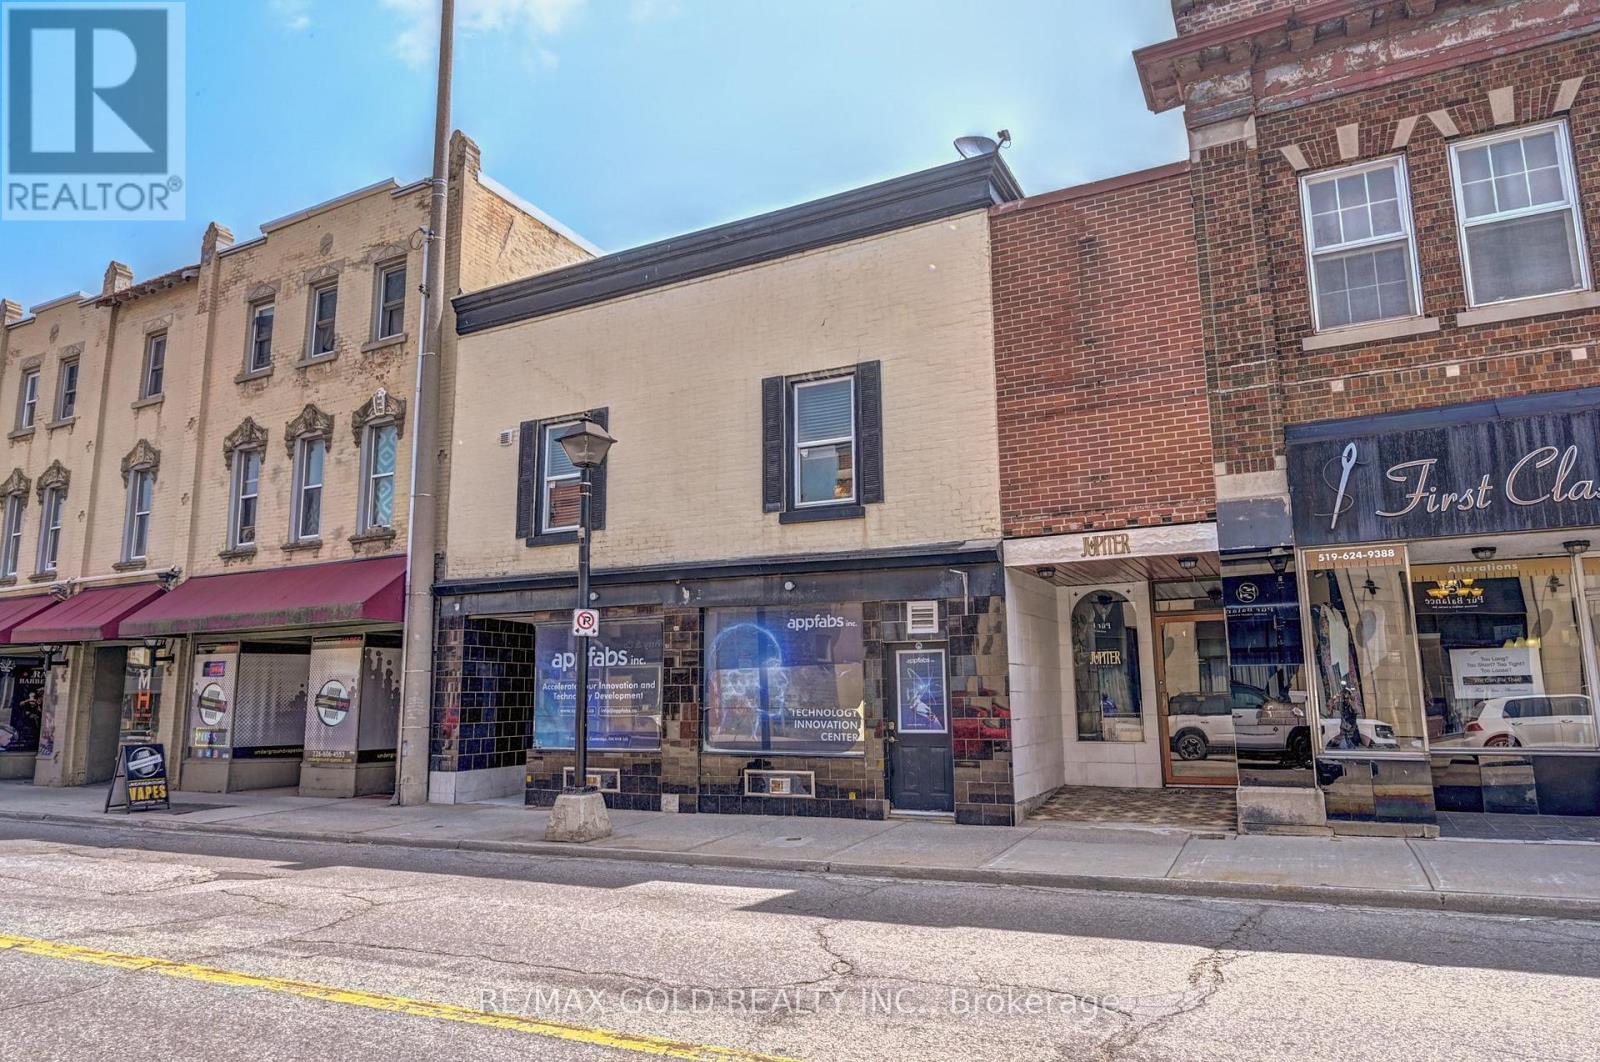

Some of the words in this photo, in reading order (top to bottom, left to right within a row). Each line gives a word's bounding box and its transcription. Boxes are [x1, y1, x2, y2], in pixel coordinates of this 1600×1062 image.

[1376, 458, 1494, 517] First
[1081, 533, 1131, 557] JUPITER
[1318, 549, 1395, 562] 519-624-9388
[1448, 563, 1518, 573] Alterations
[787, 614, 844, 631] appfabs
[630, 656, 647, 665] inc.
[1090, 651, 1121, 665] JUPITER
[599, 681, 638, 690] Innovation
[640, 680, 656, 689] and
[594, 691, 644, 701] Development
[792, 708, 857, 718] TECHNOLOGY
[794, 720, 858, 729] INNOVATION
[820, 732, 859, 741] CENTER
[129, 785, 167, 801] VAPES
